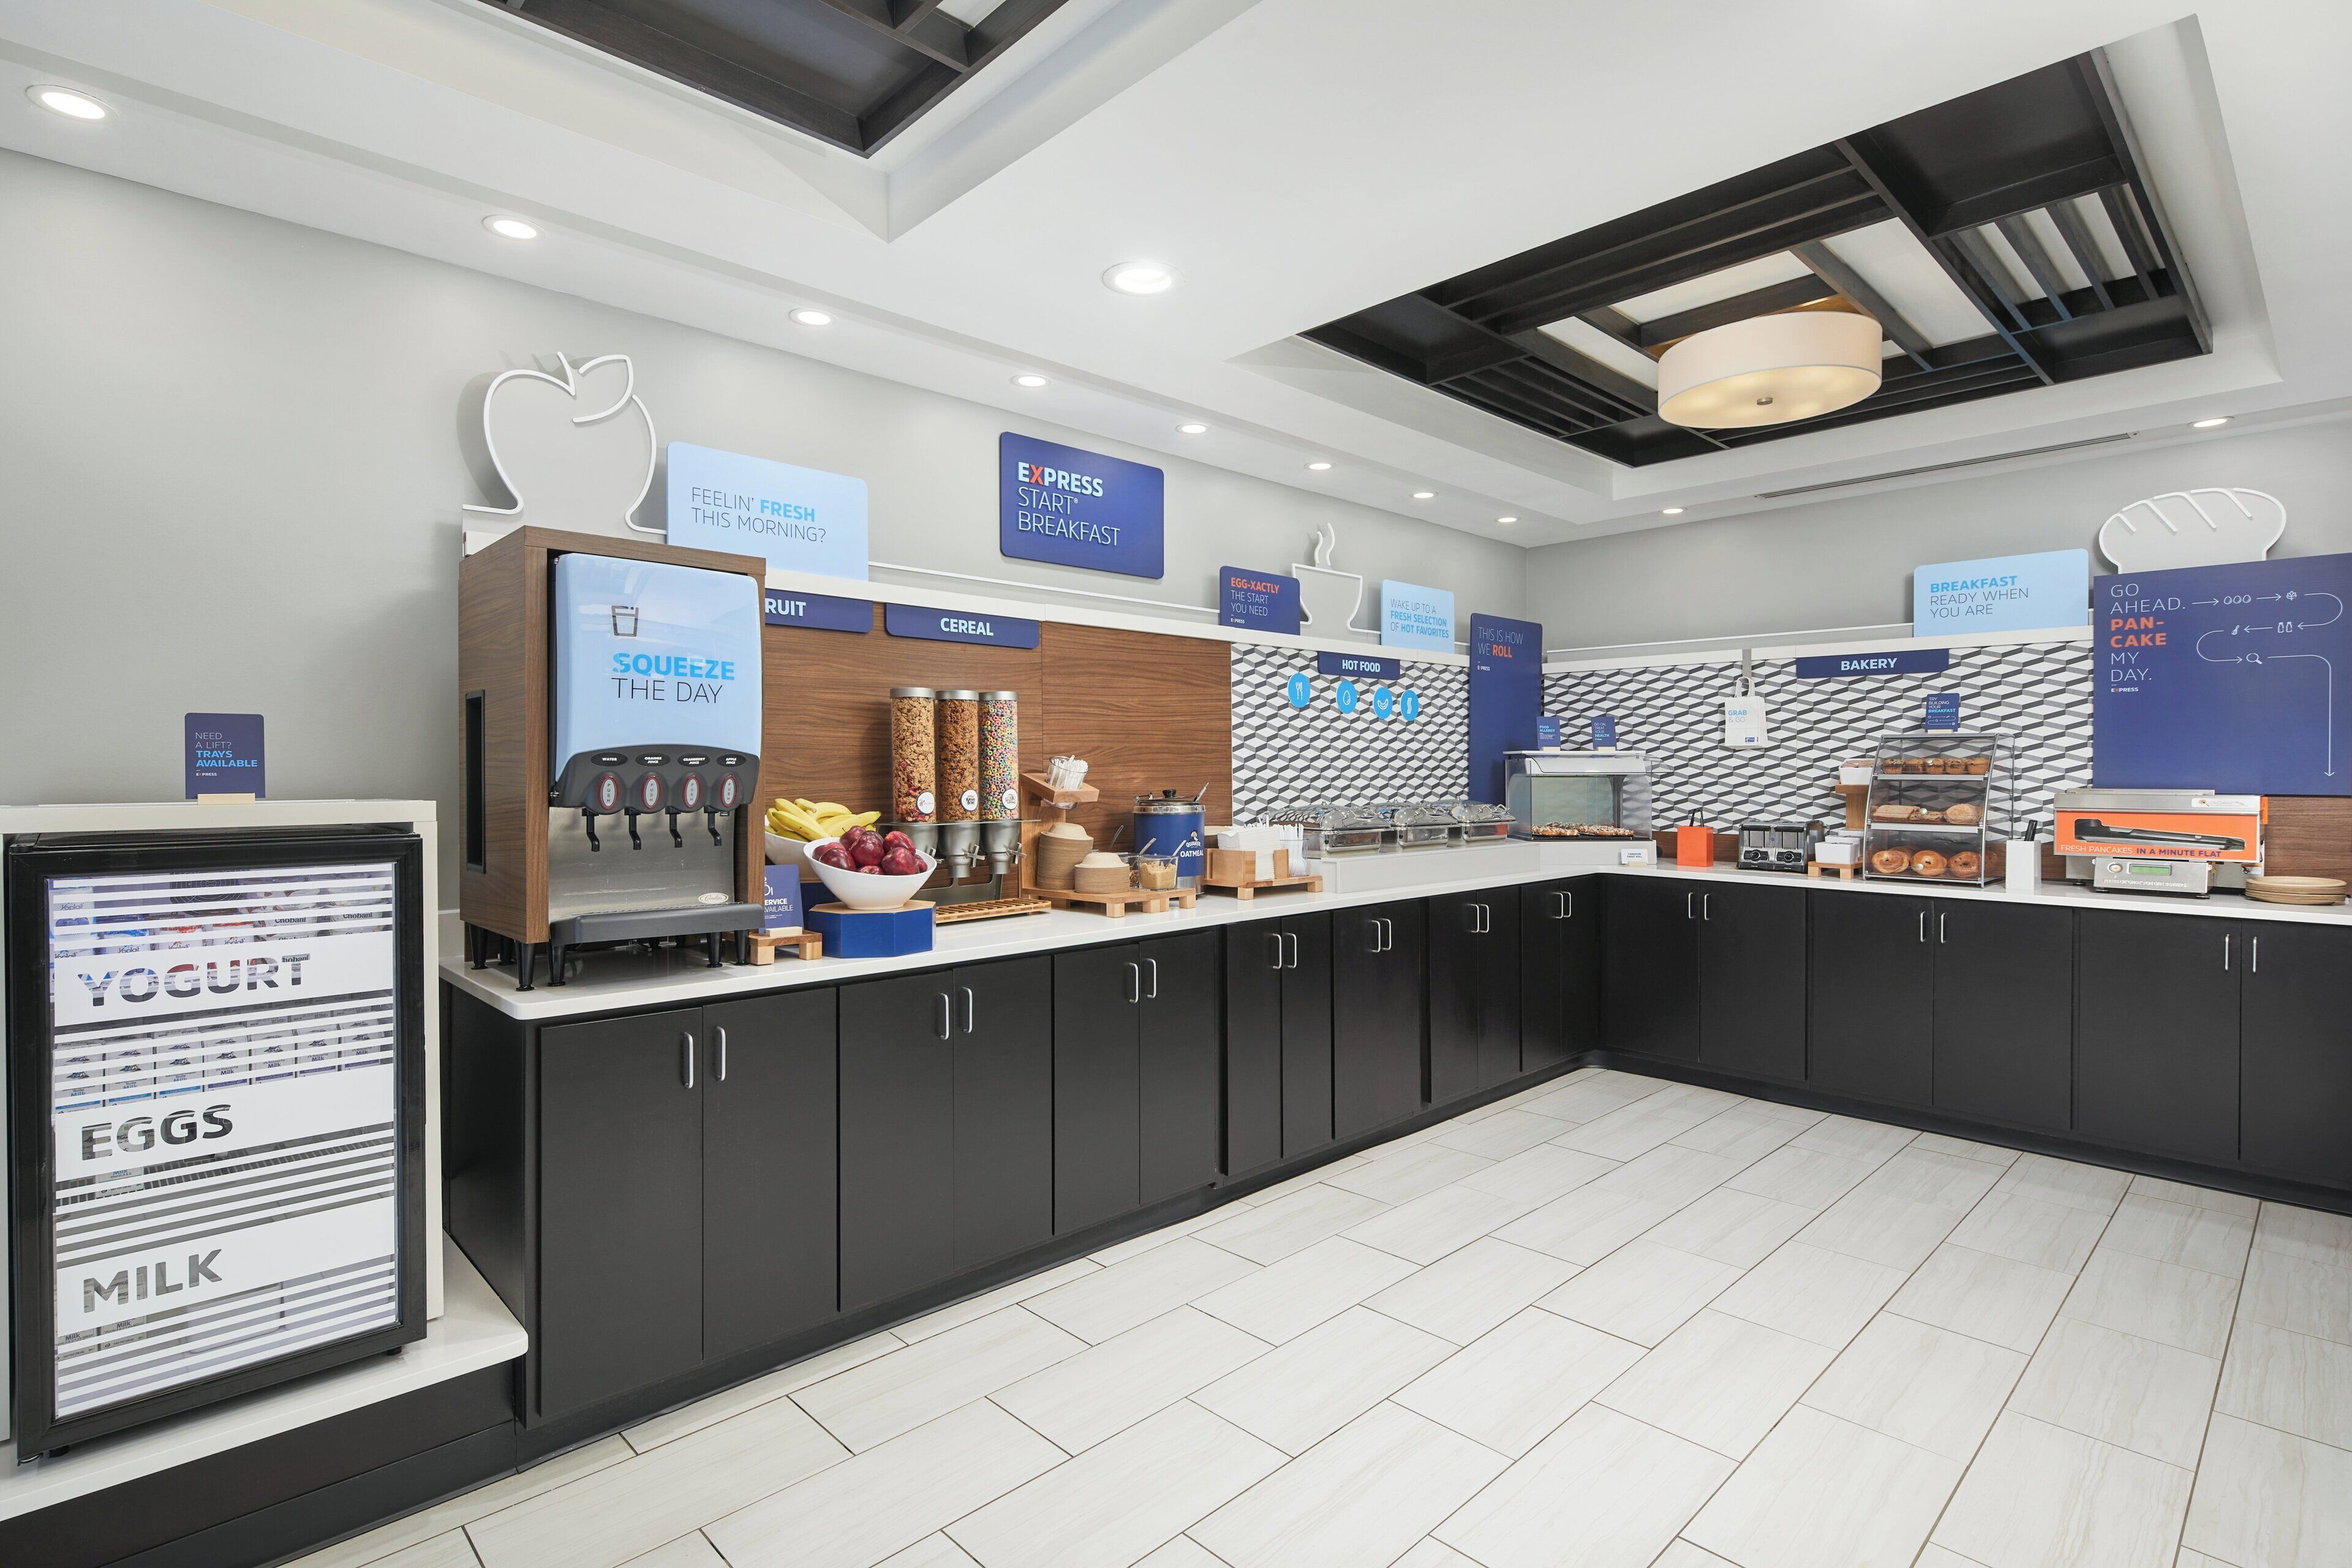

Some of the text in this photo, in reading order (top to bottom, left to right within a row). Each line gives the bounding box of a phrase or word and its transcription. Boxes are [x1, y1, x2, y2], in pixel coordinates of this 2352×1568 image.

[1018, 461, 1103, 497] EXPRESS
[692, 487, 815, 522] FEELIN' FRESH
[692, 507, 827, 543] THIS MORNING?
[1019, 510, 1120, 546] BREAKFAST
[1231, 577, 1280, 594] EGG-XACTLY
[1931, 575, 2018, 594] BREAKFAST
[2111, 583, 2139, 597] GO
[1231, 590, 1268, 605] THE START
[1931, 587, 2029, 606] READY WHEN
[765, 597, 807, 617] RUIT
[1231, 602, 1268, 616] YOU NEED
[1390, 598, 1436, 614] WAKE UP TO A
[1930, 603, 1993, 619] YOU ARE
[2110, 597, 2185, 614] AHEAD.
[940, 617, 994, 637] CEREAL
[1390, 610, 1447, 627] FRESH SELECTION
[2111, 616, 2165, 631] PAN-
[1390, 622, 1449, 638] OF HOT FAVORITES
[1478, 627, 1523, 644] THIS IS HOW
[2111, 633, 2166, 648] CAKE
[1478, 643, 1512, 658] WE ROLL
[2111, 651, 2139, 665] MY
[612, 652, 735, 680] SQUEEZE
[1342, 659, 1381, 673] HOT FOOD
[1841, 657, 1898, 671] BAKERY
[2111, 668, 2152, 682] DAY.
[611, 677, 723, 704] THE DAY
[77, 954, 311, 1006] YOGURT
[82, 1104, 233, 1161] EGGS
[83, 1249, 222, 1313] MILK
[65, 1332, 80, 1341] Milk
